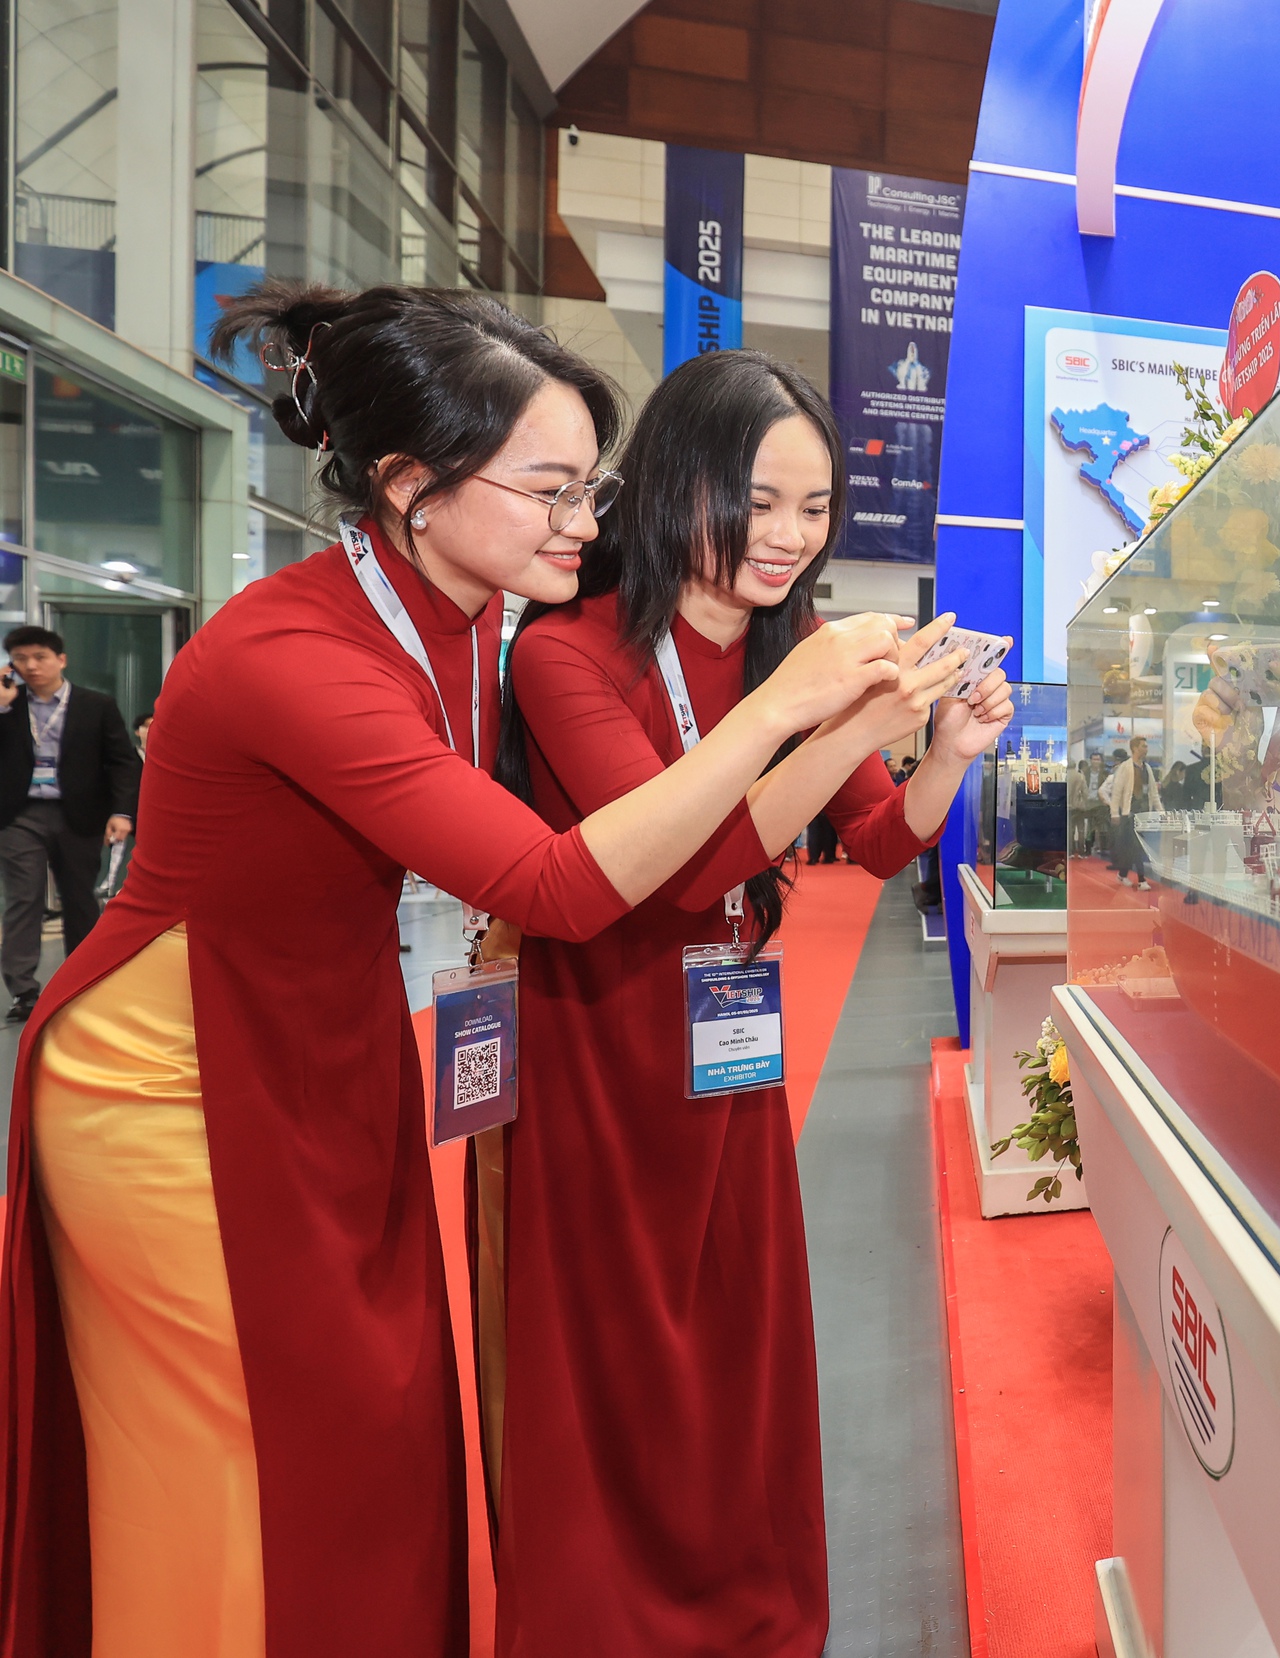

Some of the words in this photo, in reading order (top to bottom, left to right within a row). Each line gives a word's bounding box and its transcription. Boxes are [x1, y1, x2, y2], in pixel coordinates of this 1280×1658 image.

[882, 187, 935, 204] Consulting
[935, 195, 956, 206] JSC
[860, 222, 895, 241] THE
[900, 227, 962, 250] LEADIN
[698, 220, 721, 283] 2025
[870, 244, 957, 271] MARITIME
[870, 287, 955, 312] COMPANY
[861, 307, 879, 325] IN
[1065, 355, 1091, 368] SBIC
[1257, 340, 1274, 369] 2025
[1147, 362, 1178, 377] MAIN
[860, 390, 907, 402] AUTHORIZED
[870, 399, 904, 409] SYSTEMS
[862, 407, 879, 416] AND
[879, 408, 910, 419] SERVICE
[910, 411, 939, 421] CENTER
[849, 474, 880, 482] VOLVO
[891, 478, 923, 490] ComAp
[853, 511, 907, 525] MARTAC
[709, 985, 763, 1008] VIETSHIP
[464, 1014, 493, 1028] DOWNLOAD
[454, 1028, 471, 1039] SHOW
[471, 1021, 502, 1035] CATALOGUE
[730, 1037, 745, 1045] Minh
[707, 1066, 726, 1077] NHÀ
[727, 1063, 755, 1074] TRƯNG
[755, 1060, 771, 1069] BÀY
[723, 1072, 757, 1083] EXHIBITOR
[1171, 1265, 1217, 1413] SBIC
